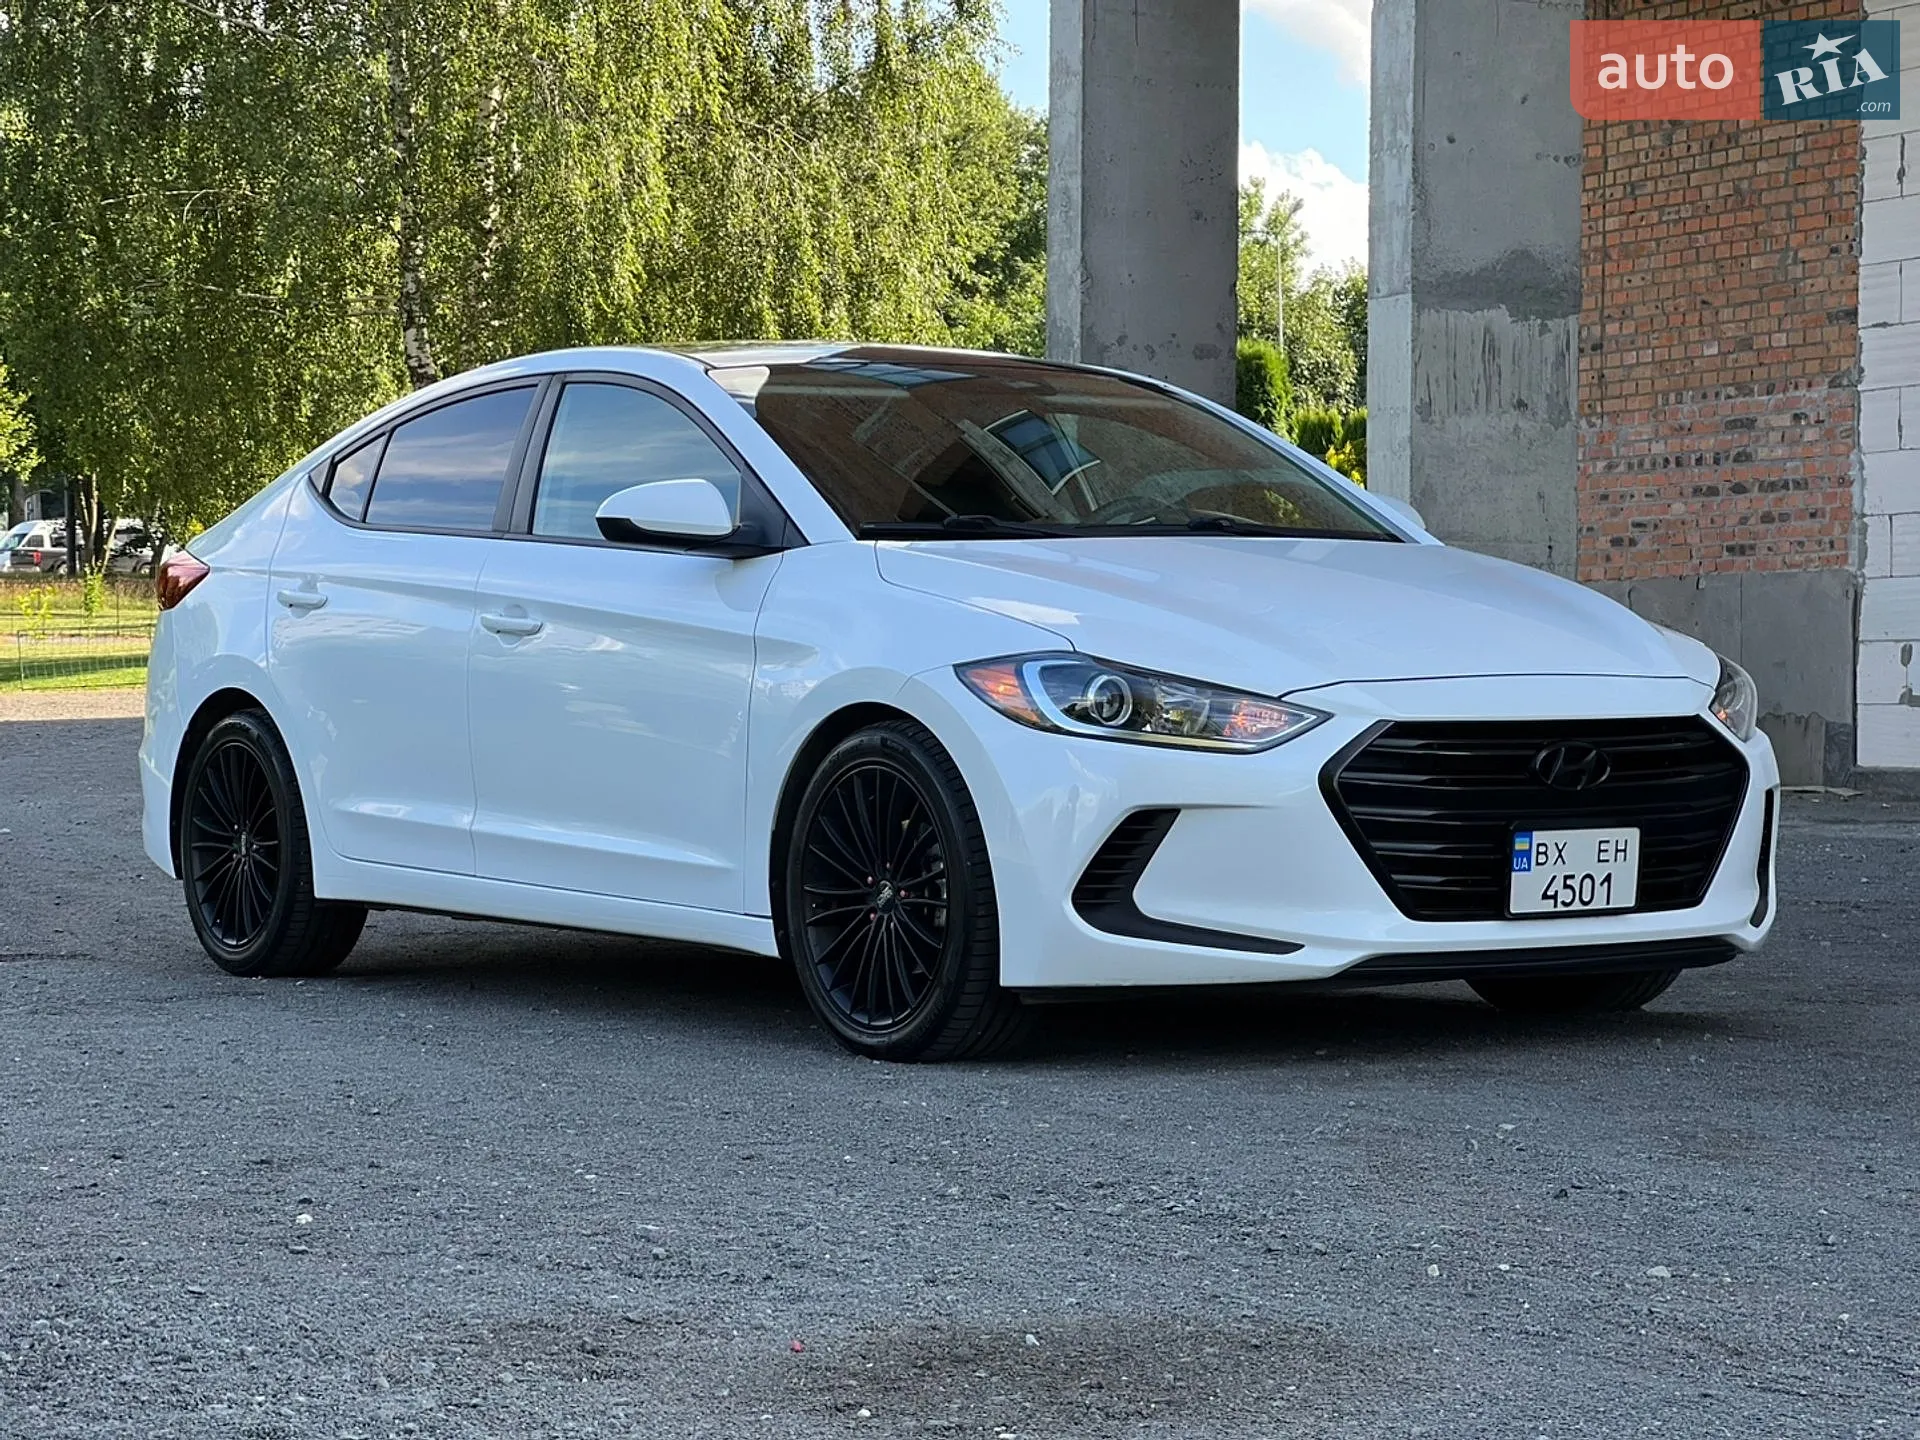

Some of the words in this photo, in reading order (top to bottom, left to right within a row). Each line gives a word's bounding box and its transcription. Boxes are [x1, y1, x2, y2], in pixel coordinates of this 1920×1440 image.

[1513, 857, 1529, 870] UA
[1535, 841, 1568, 866] BX
[1597, 838, 1628, 863] EH
[1541, 872, 1612, 909] 4501
